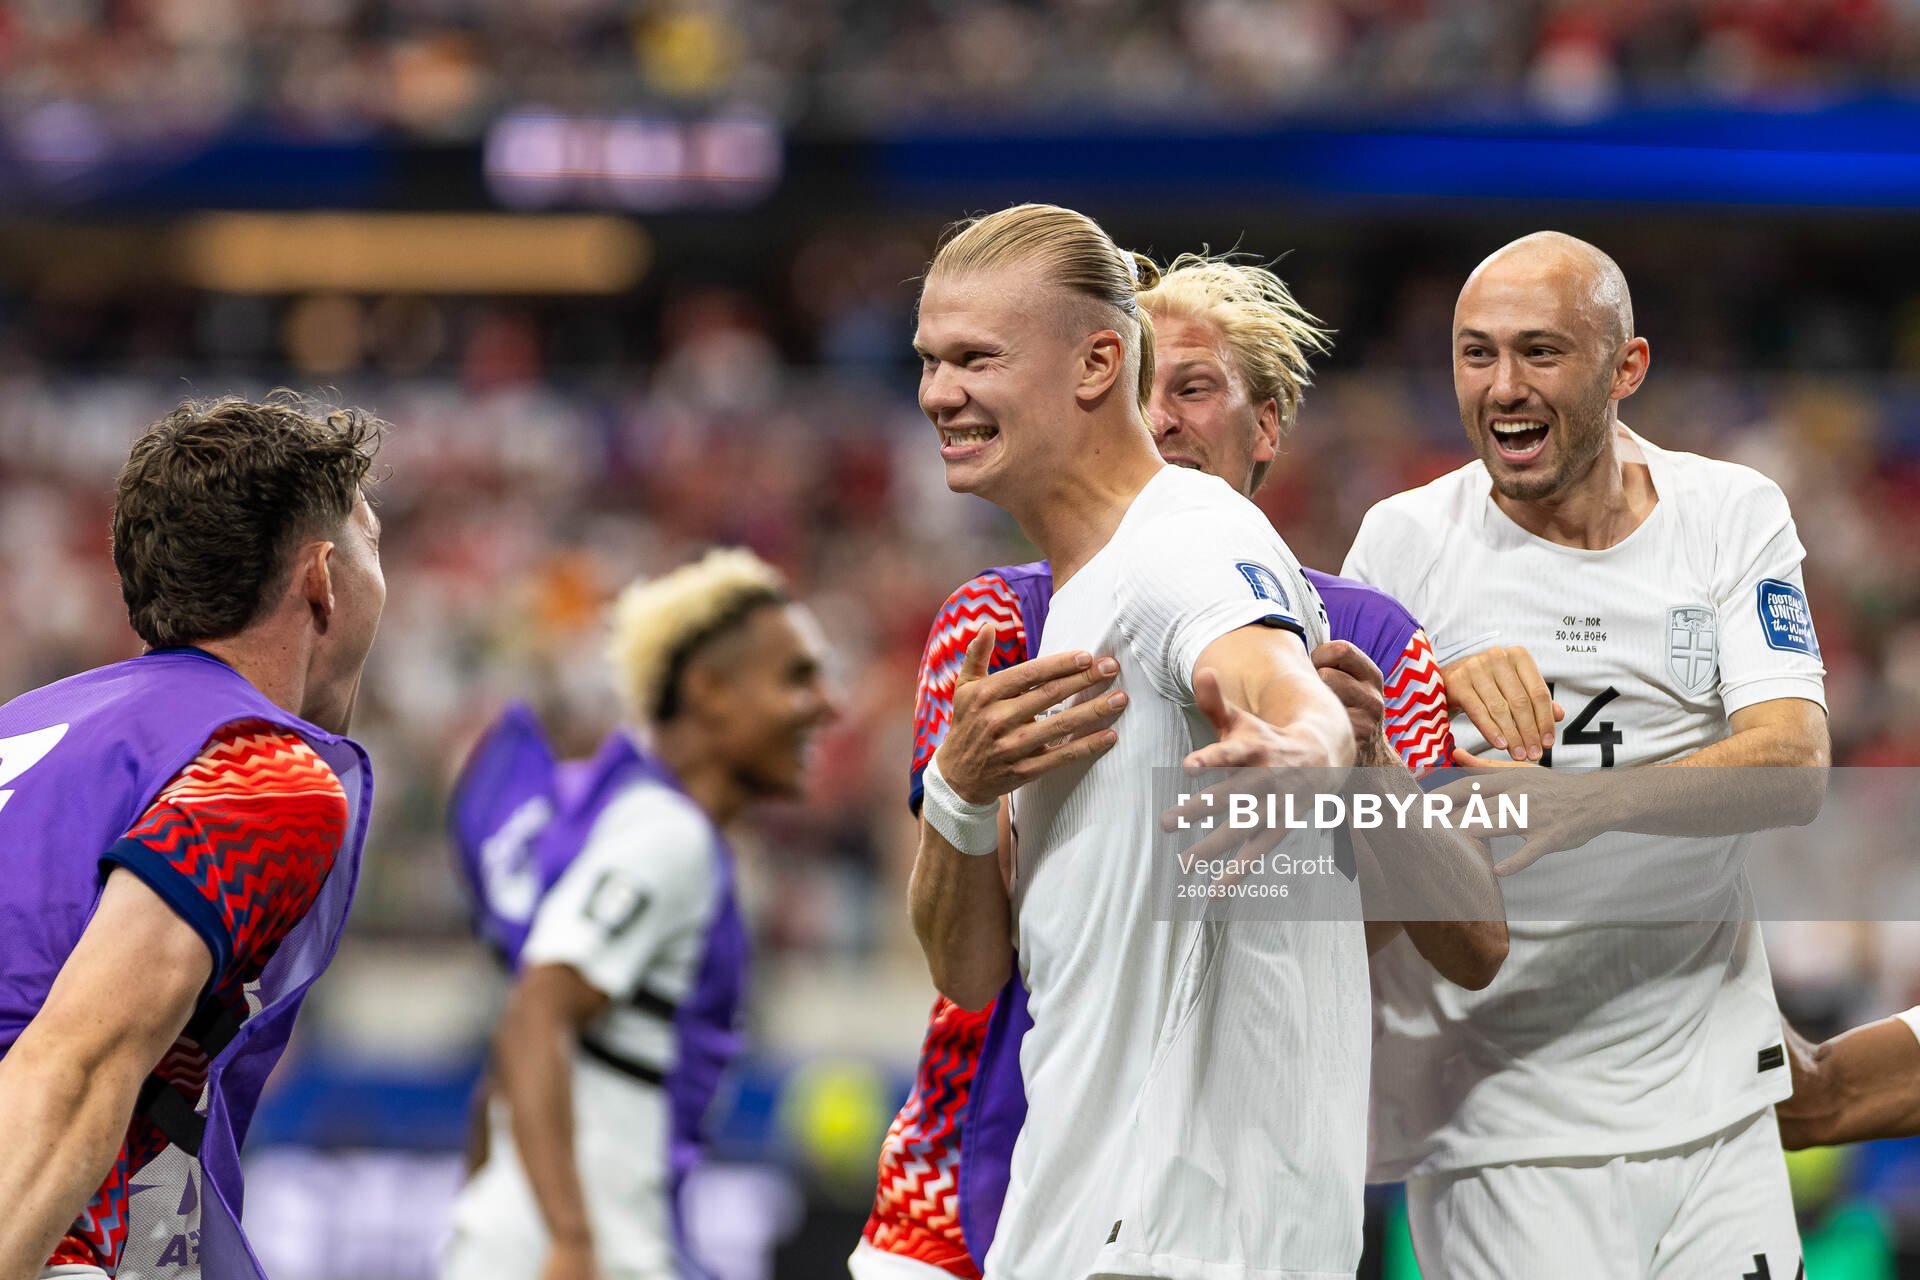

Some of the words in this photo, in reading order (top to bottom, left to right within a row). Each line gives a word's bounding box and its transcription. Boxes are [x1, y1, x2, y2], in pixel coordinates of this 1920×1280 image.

[1562, 616, 1576, 626] CIV
[1771, 618, 1788, 631] the
[1555, 630, 1607, 641] 30.06.2026
[1566, 645, 1597, 653] DALLAS
